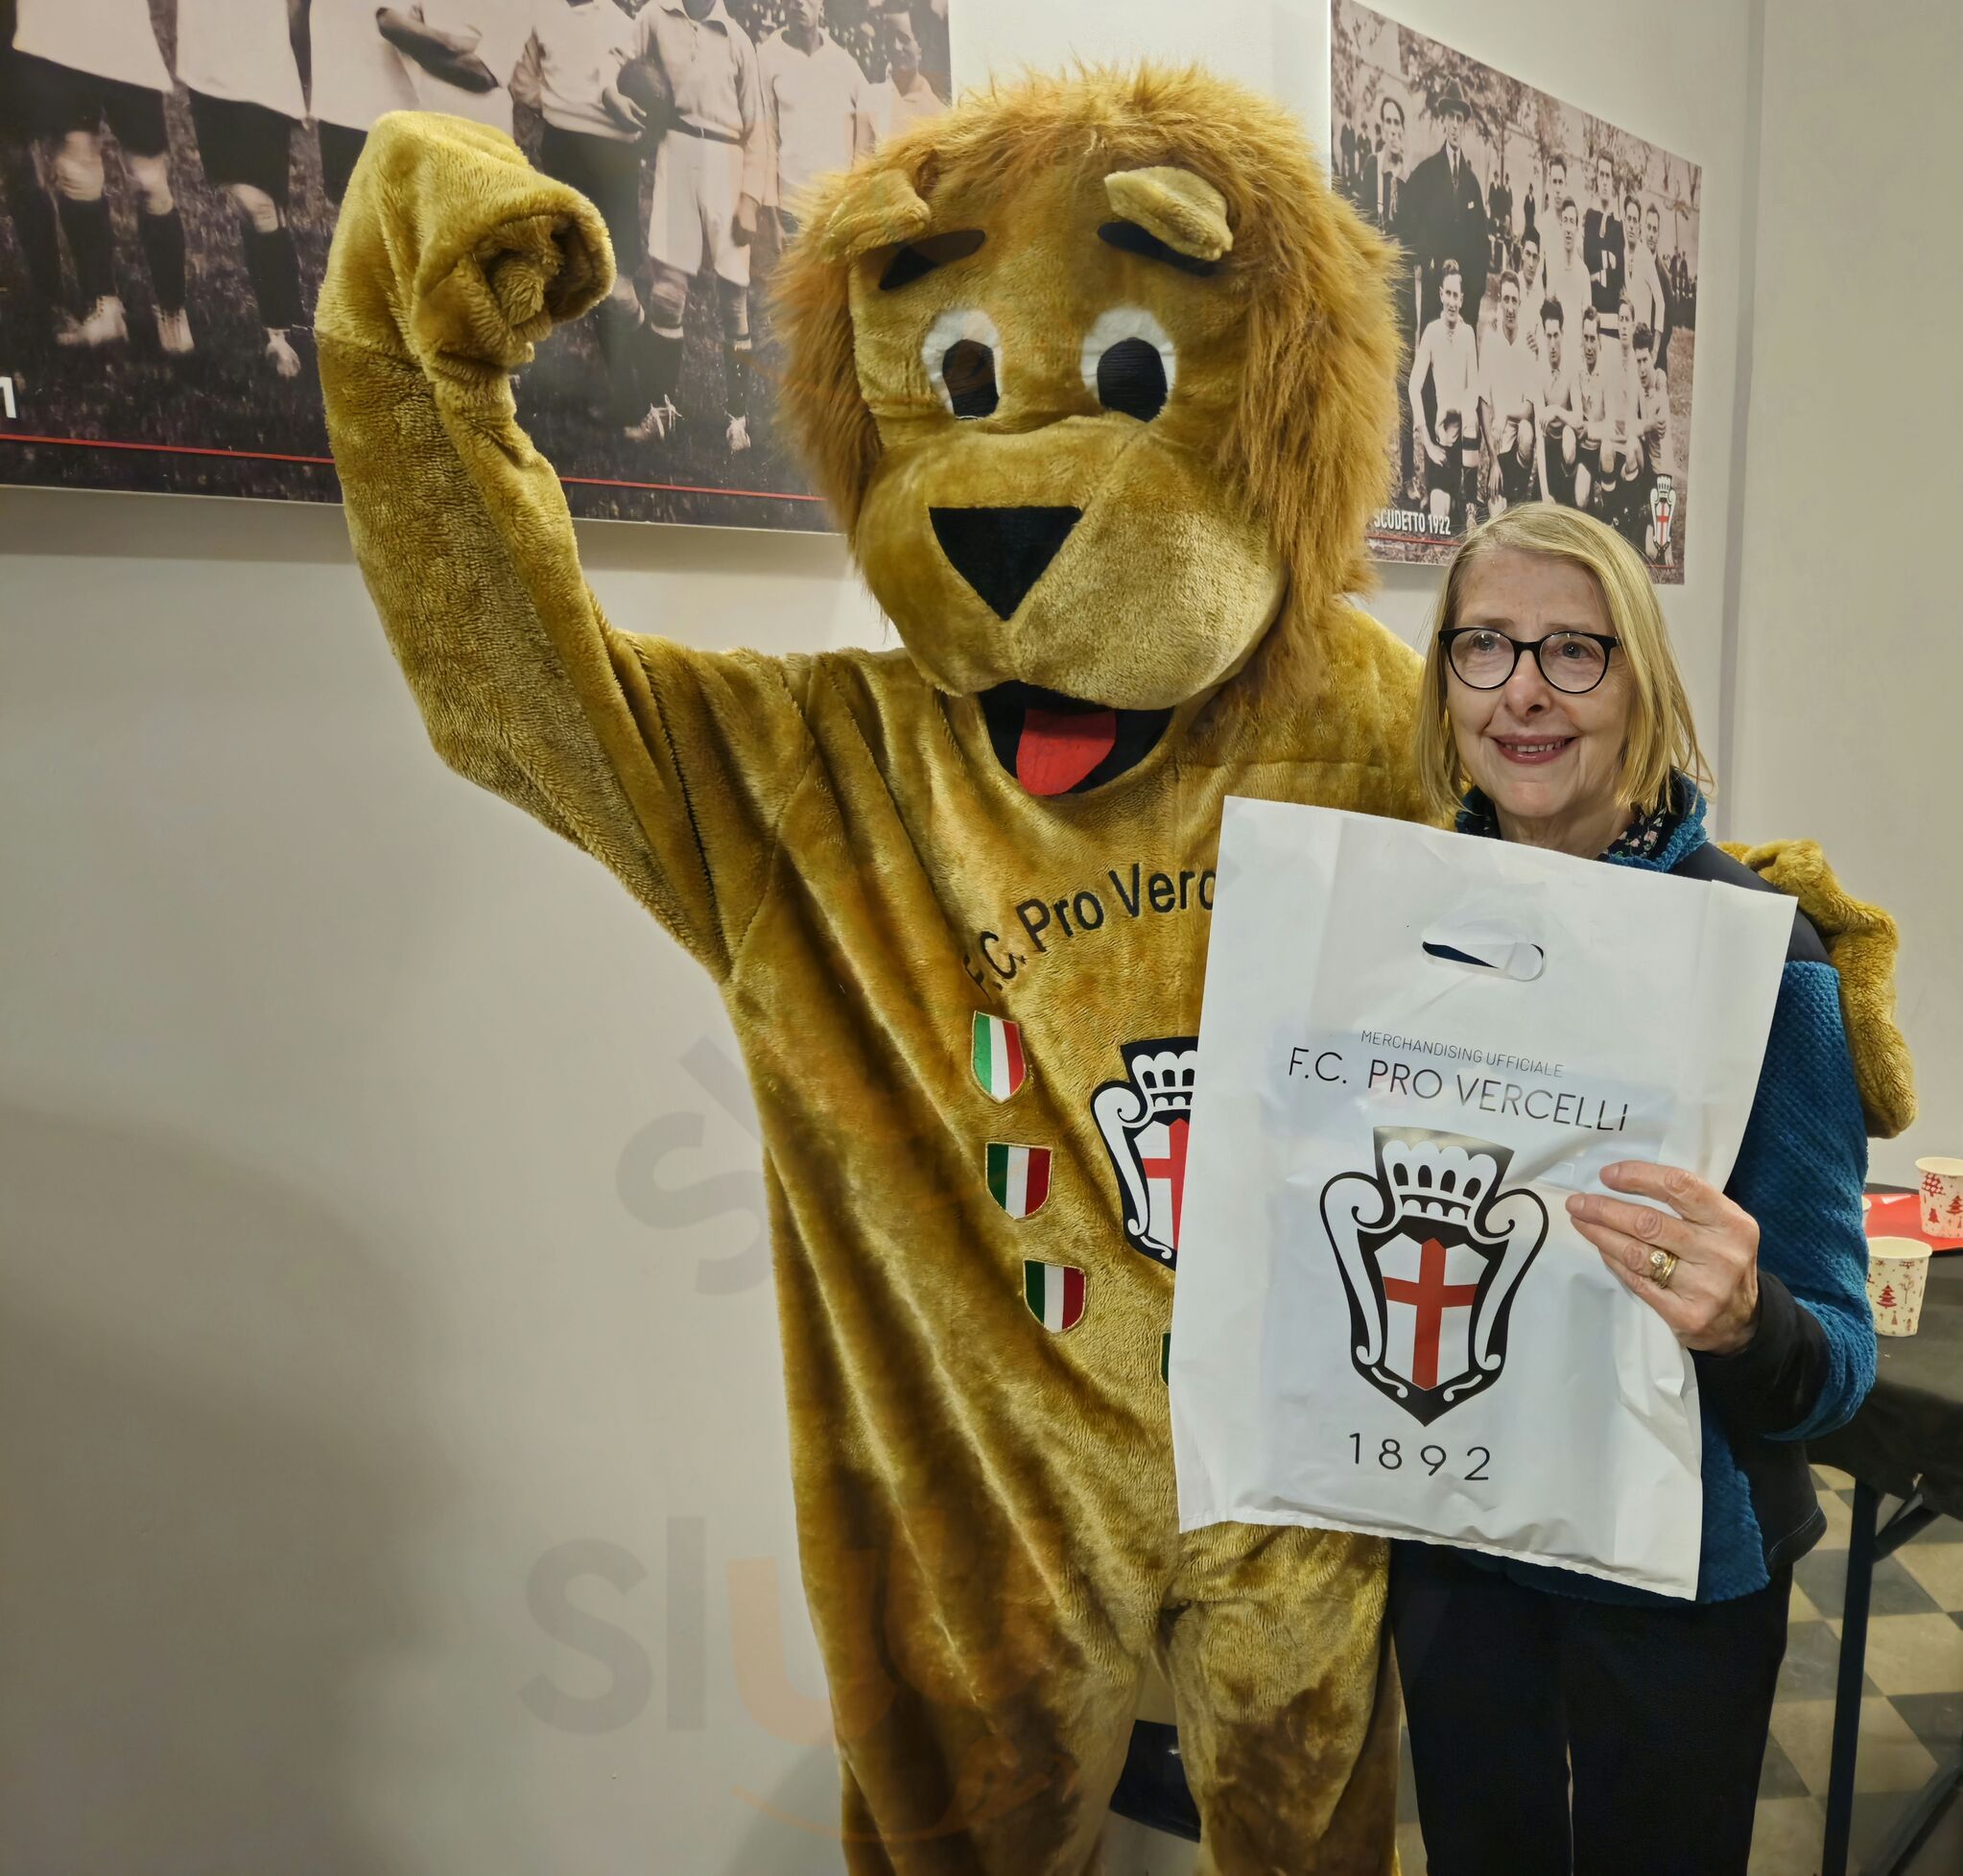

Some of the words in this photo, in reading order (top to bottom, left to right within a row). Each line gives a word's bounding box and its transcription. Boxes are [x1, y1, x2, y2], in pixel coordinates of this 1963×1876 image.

[1374, 508, 1426, 533] SCUDETTO
[1428, 513, 1452, 535] 1922
[1015, 898, 1104, 952] Pro
[1360, 1030, 1482, 1063] MERCHANDISING
[1486, 1052, 1565, 1080] UFFICIALE
[1289, 1046, 1347, 1084] F.C.
[1368, 1058, 1443, 1100] PRO
[1456, 1073, 1628, 1131] VERCELLI
[1349, 1432, 1491, 1482] 1892
